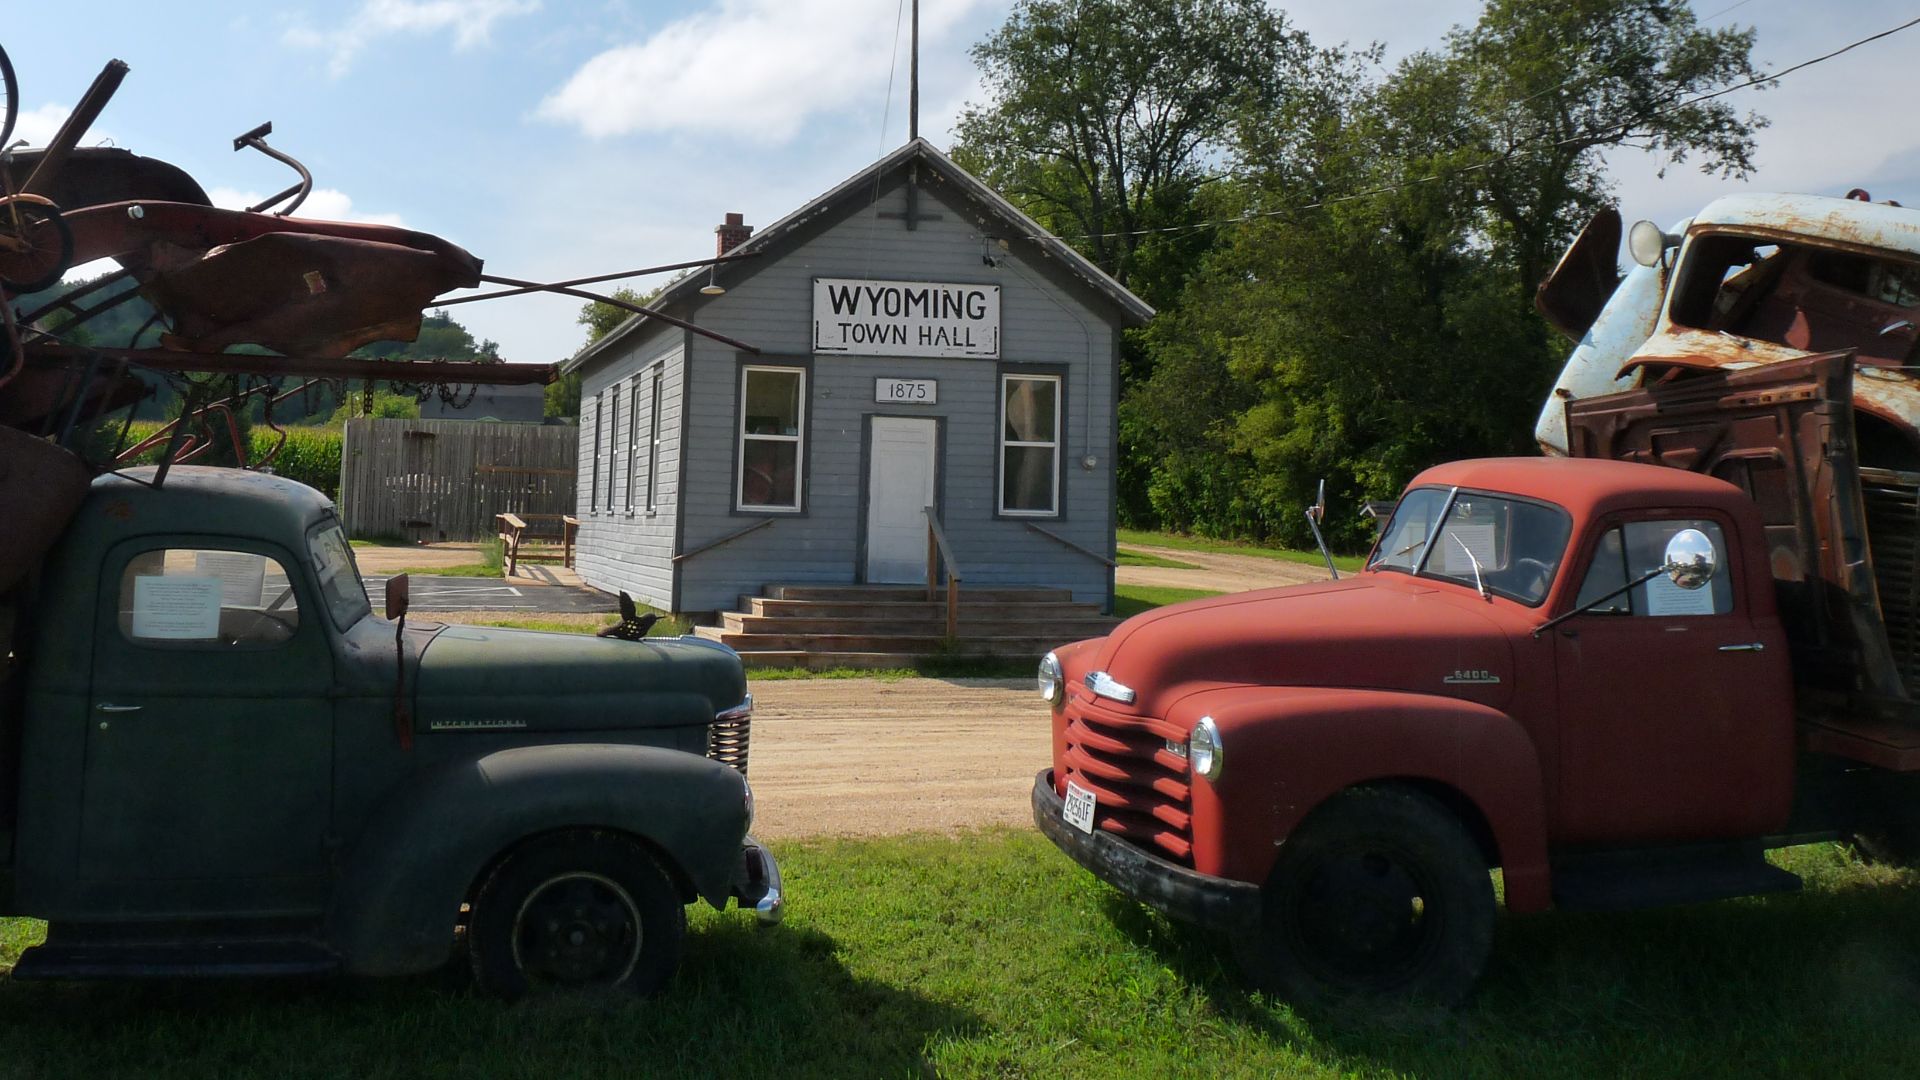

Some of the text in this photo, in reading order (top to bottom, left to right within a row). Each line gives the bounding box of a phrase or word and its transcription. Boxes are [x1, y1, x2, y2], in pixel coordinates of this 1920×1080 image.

[828, 284, 987, 320] WYOMING
[837, 322, 977, 347] TOWN HALL
[889, 383, 927, 399] 1875
[430, 720, 527, 729] INTERNATIONAL
